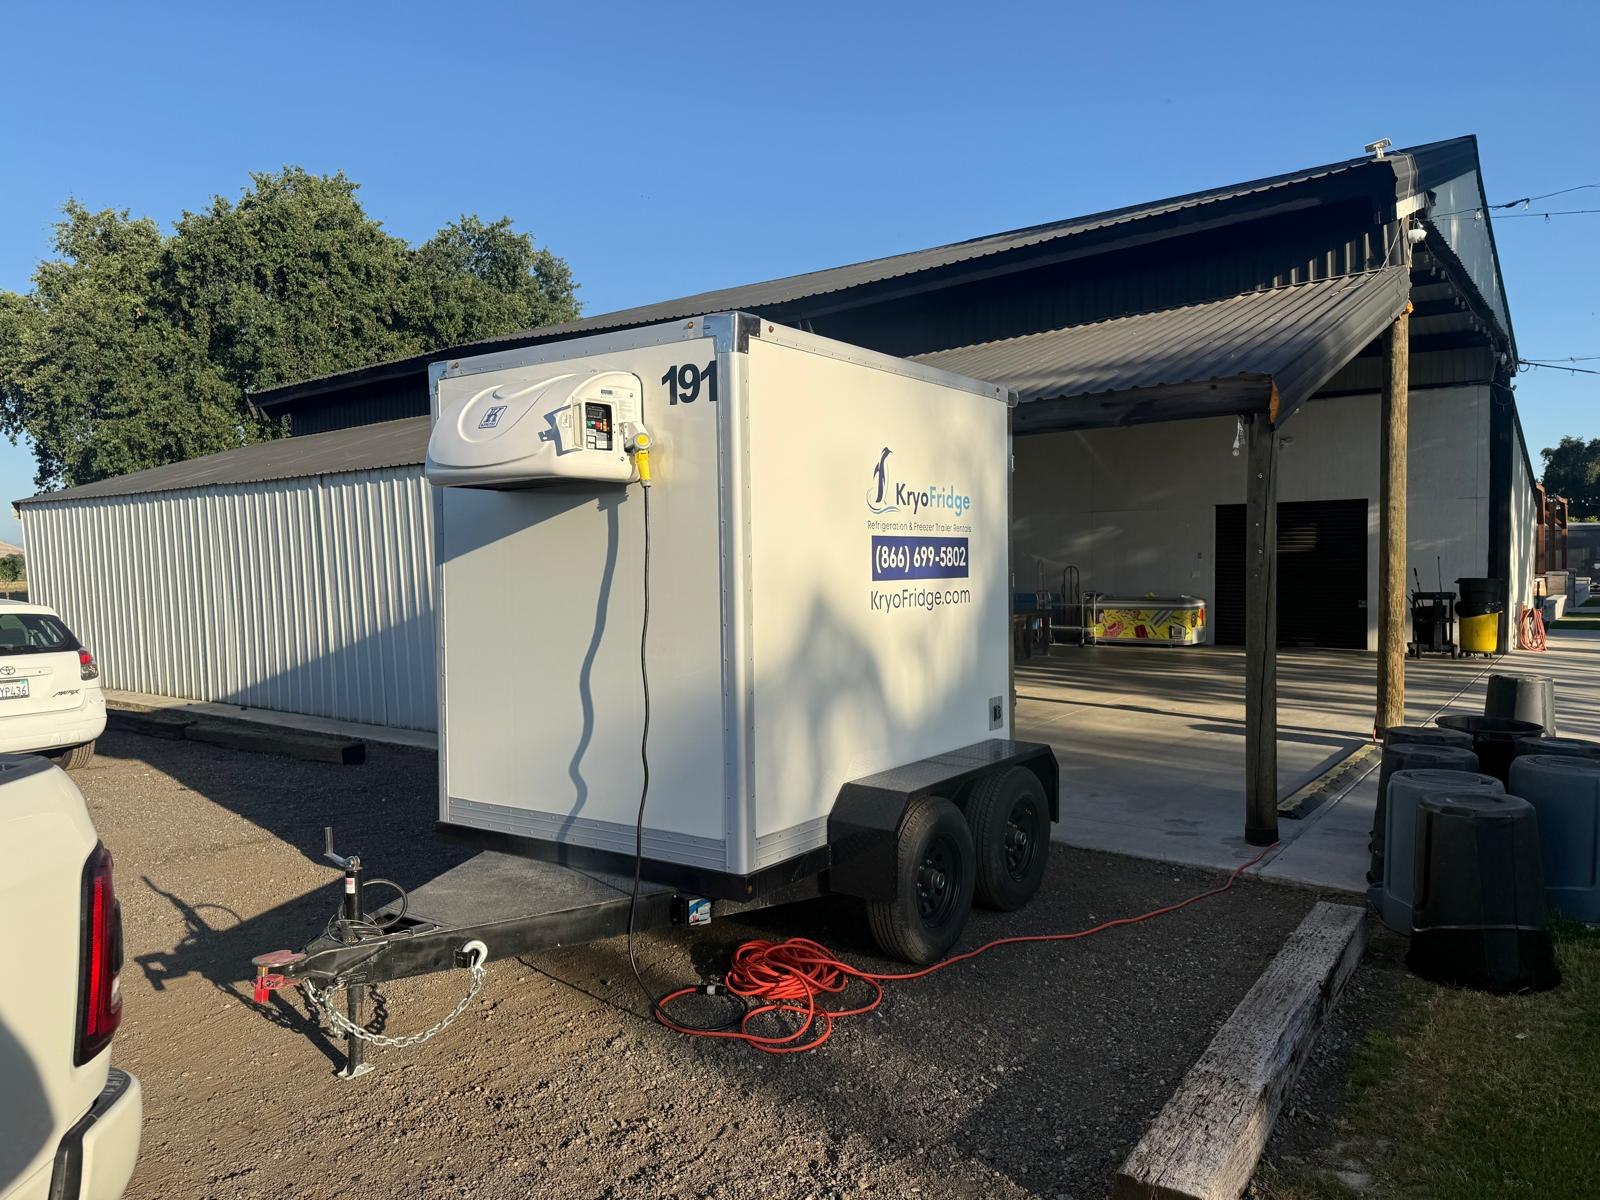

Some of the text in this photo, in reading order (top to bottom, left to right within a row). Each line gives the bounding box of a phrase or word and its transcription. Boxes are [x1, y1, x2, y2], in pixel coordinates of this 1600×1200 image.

[661, 360, 718, 405] 191
[896, 482, 970, 517] KryoFridge
[867, 520, 972, 533] Refrigeration & Freezer Trailer Rentals
[876, 545, 966, 574] (866) 699-5802
[870, 588, 971, 613] KryoFridge.com
